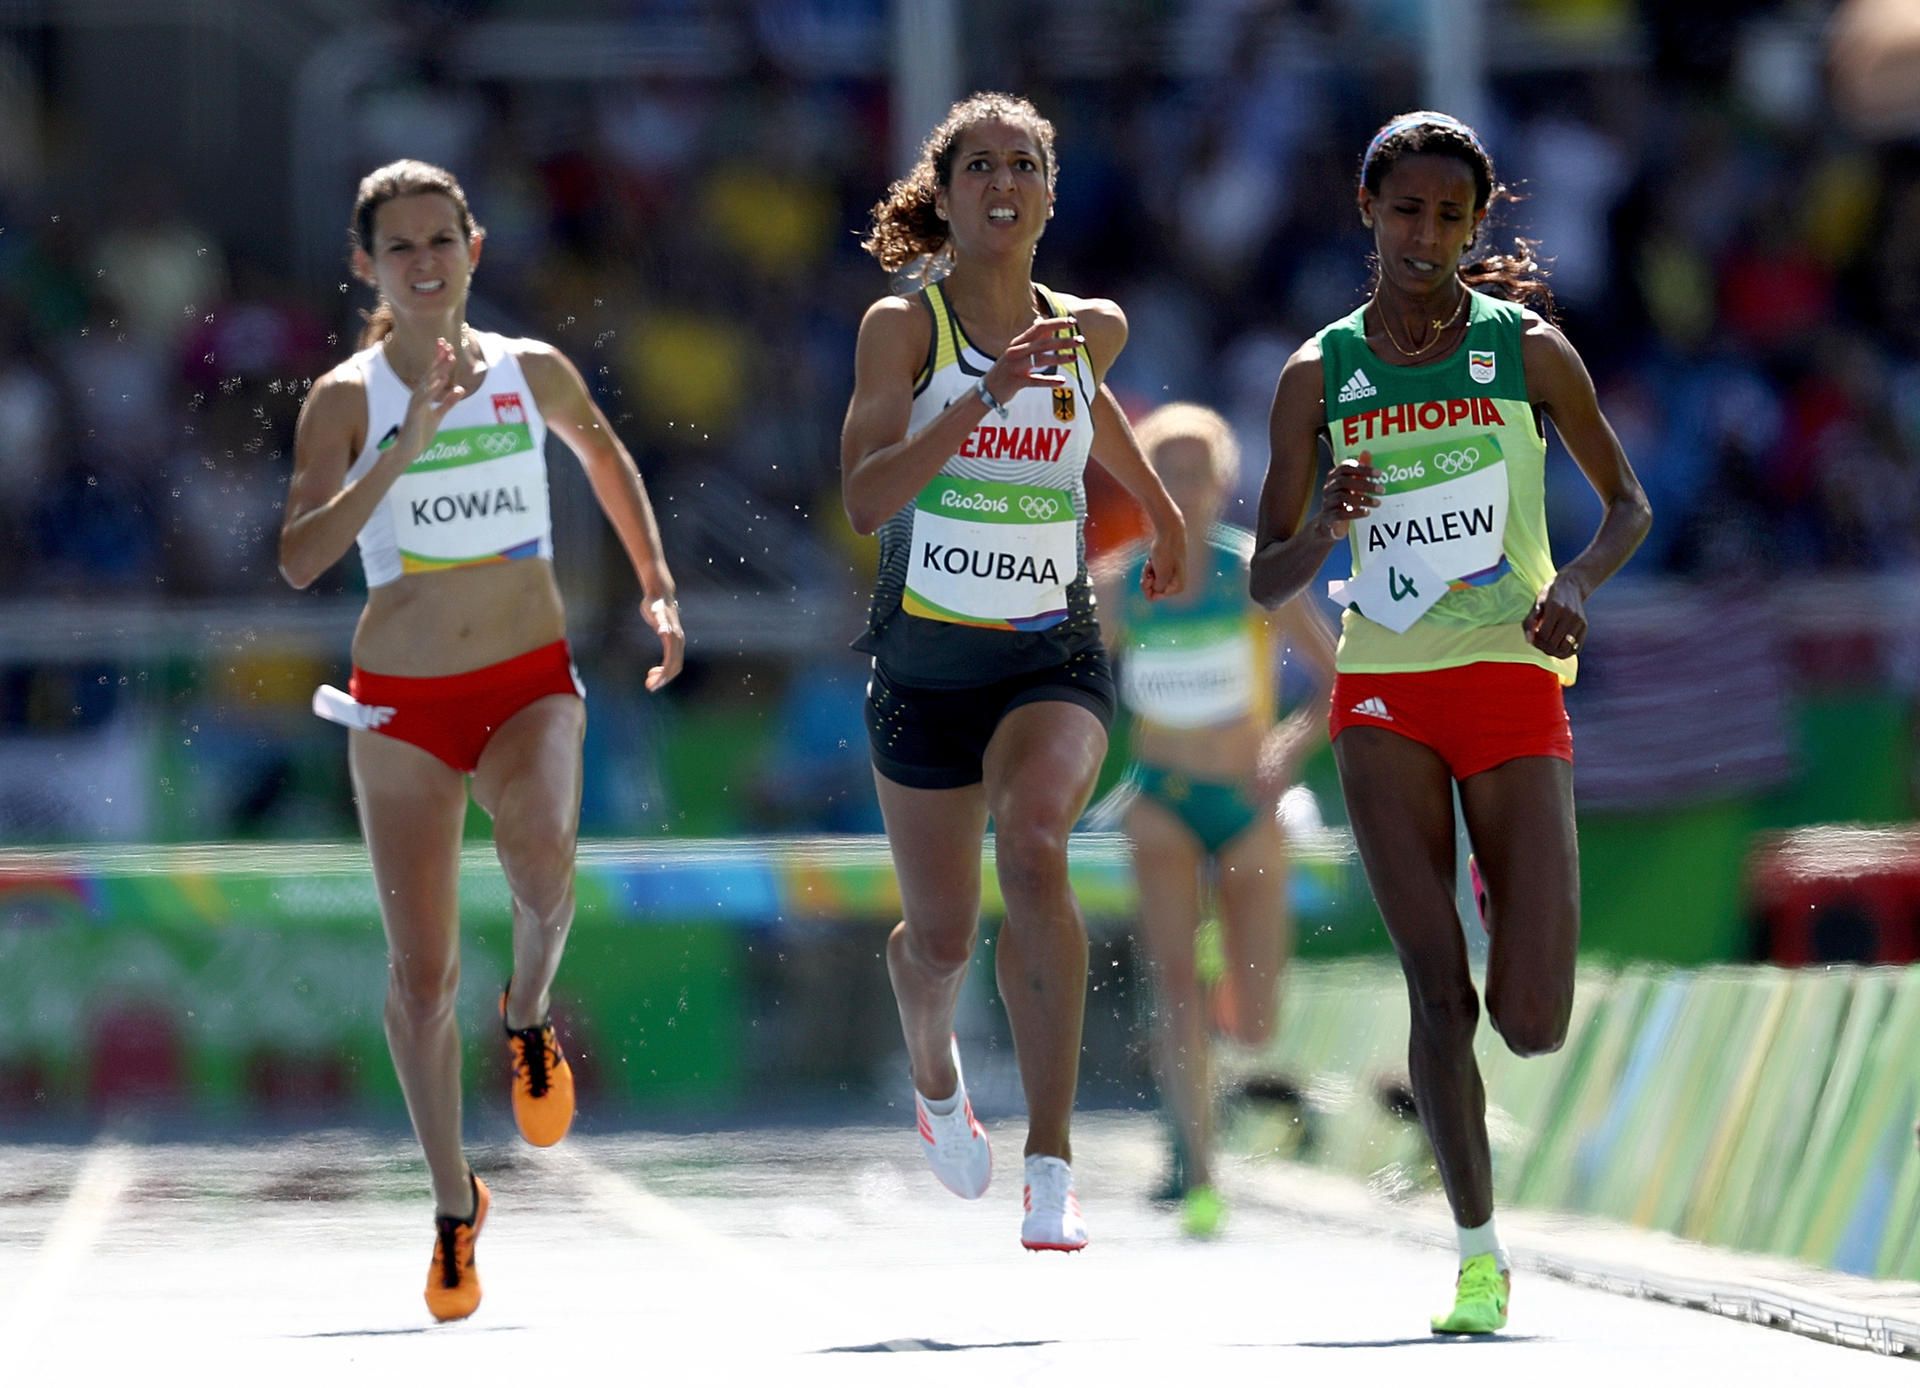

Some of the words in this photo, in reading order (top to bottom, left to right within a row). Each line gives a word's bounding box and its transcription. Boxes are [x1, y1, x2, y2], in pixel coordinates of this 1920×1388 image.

[1338, 384, 1377, 403] adidas
[1342, 398, 1506, 446] ETHIOPIA
[959, 426, 1072, 462] ERMANY
[411, 486, 528, 526] KOWAL
[940, 489, 1009, 513] Rio2016
[1368, 505, 1494, 552] AYALEW
[923, 542, 1060, 585] KOUBAA
[1388, 566, 1419, 601] 4
